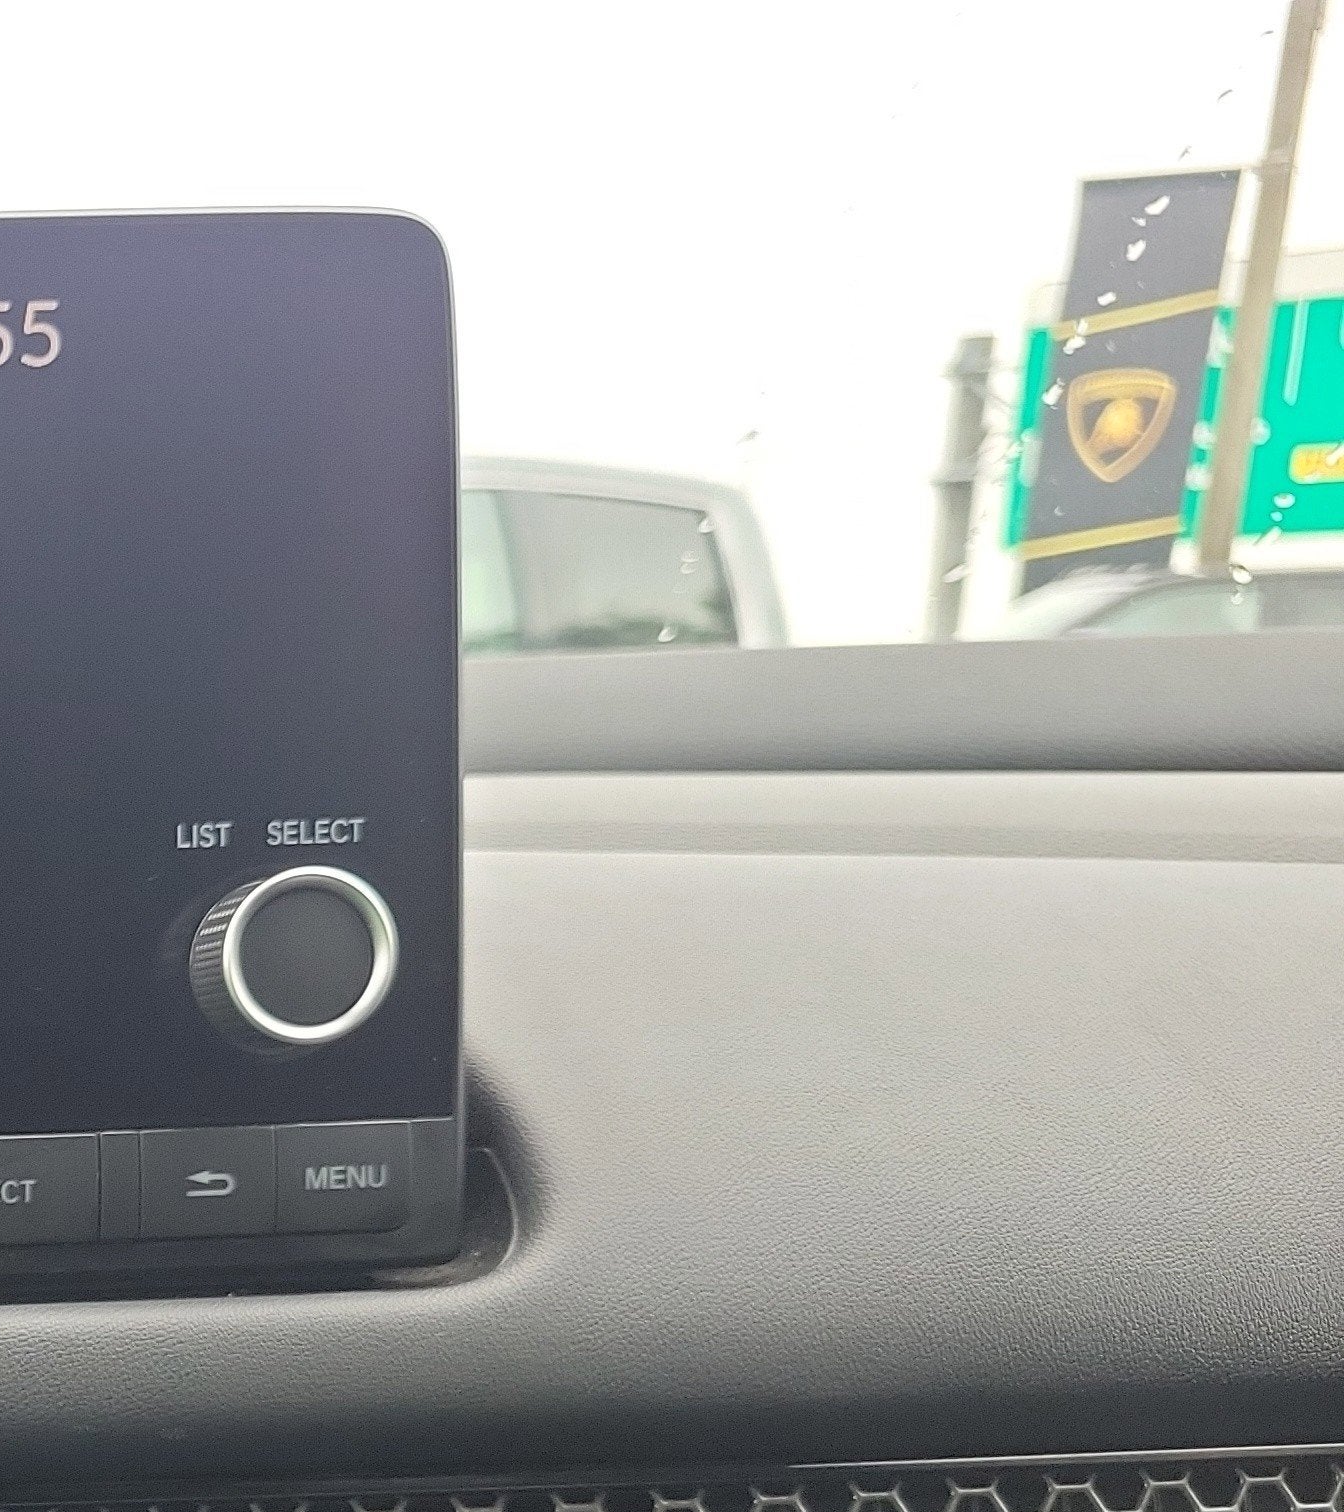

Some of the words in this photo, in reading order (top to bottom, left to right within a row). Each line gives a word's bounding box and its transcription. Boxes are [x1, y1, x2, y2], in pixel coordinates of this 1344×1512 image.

[176, 821, 232, 849] LIST
[266, 817, 365, 846] SELECT
[305, 1164, 388, 1190] MENU
